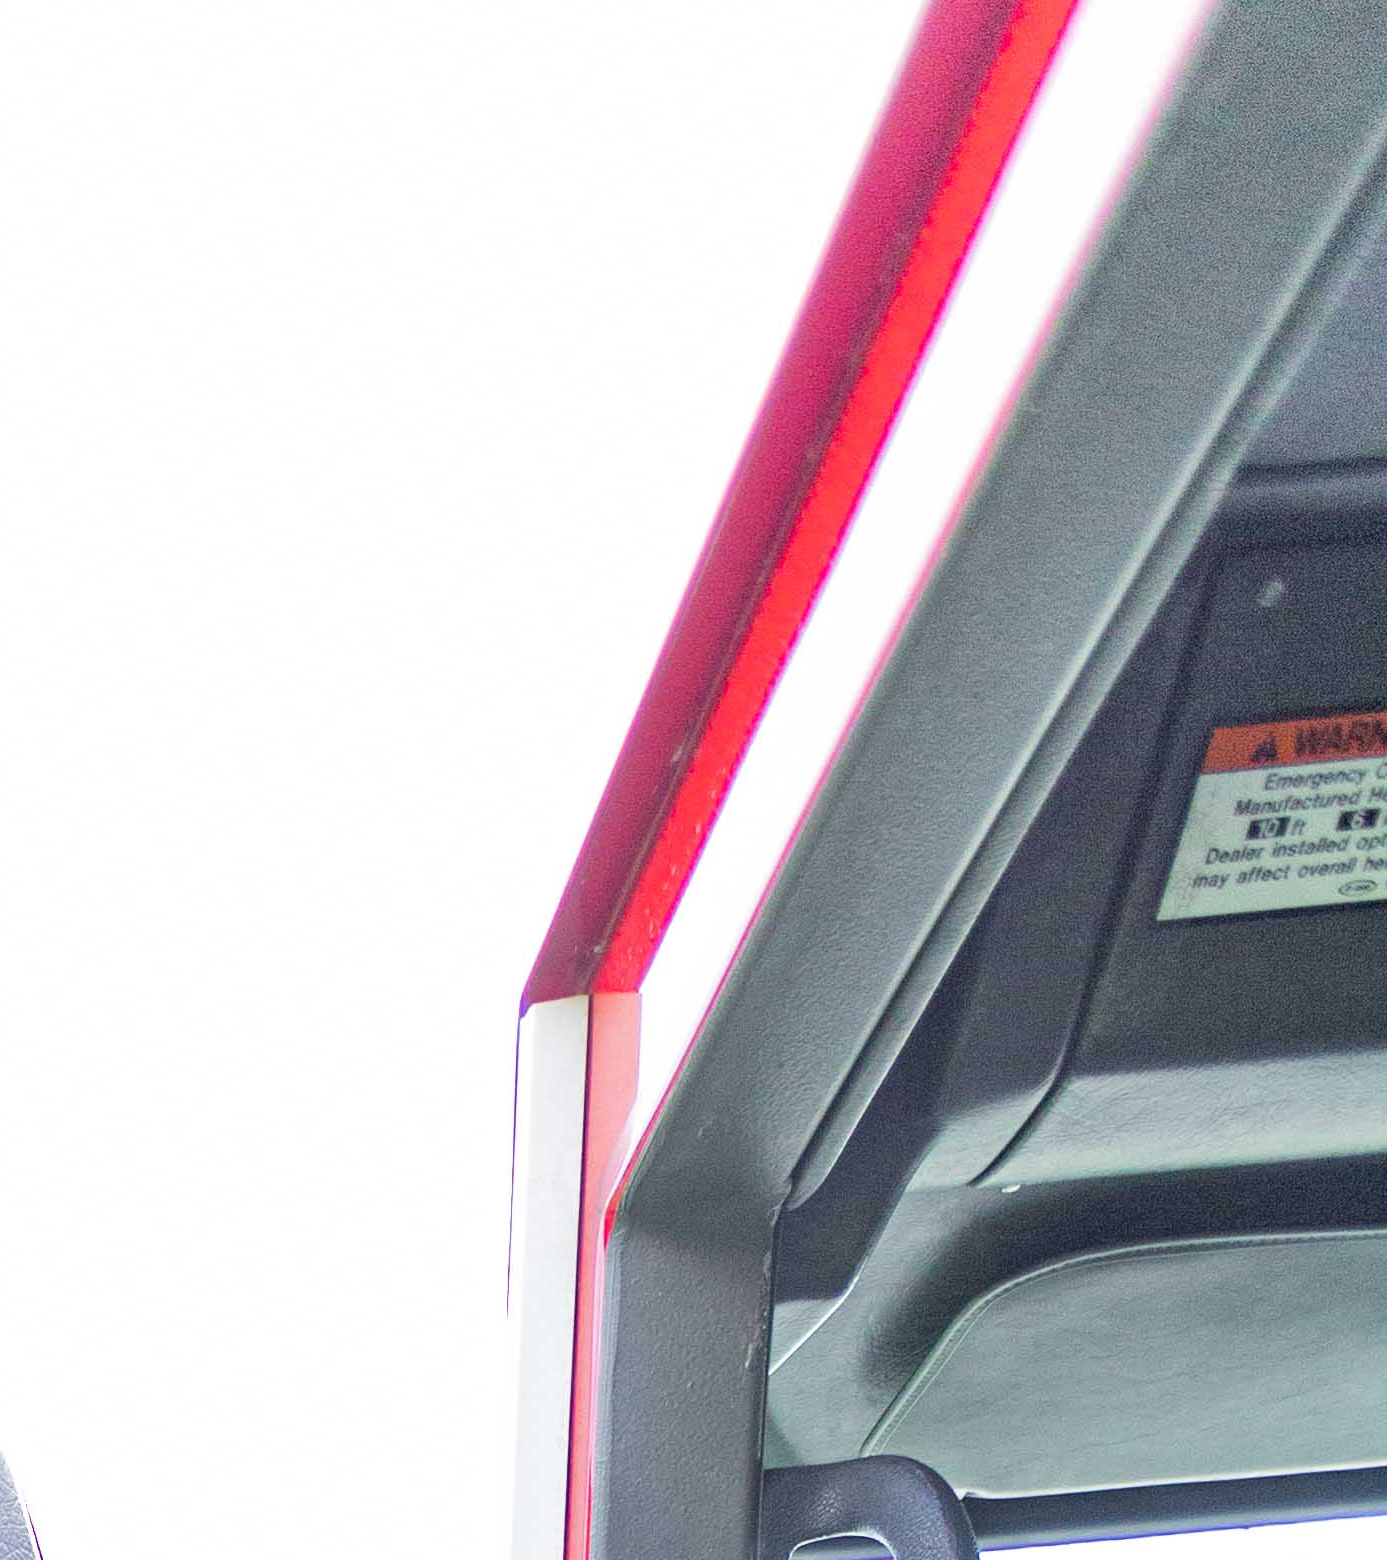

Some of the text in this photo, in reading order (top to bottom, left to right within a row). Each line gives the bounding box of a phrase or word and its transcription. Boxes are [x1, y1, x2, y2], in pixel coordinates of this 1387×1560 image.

[1264, 768, 1368, 790] Emergency
[1233, 792, 1362, 815] Manufactured
[1205, 846, 1262, 865] Dealer
[1272, 836, 1349, 857] installed
[1192, 872, 1230, 889] may
[1236, 865, 1290, 885] affect
[1297, 857, 1358, 878] overall
